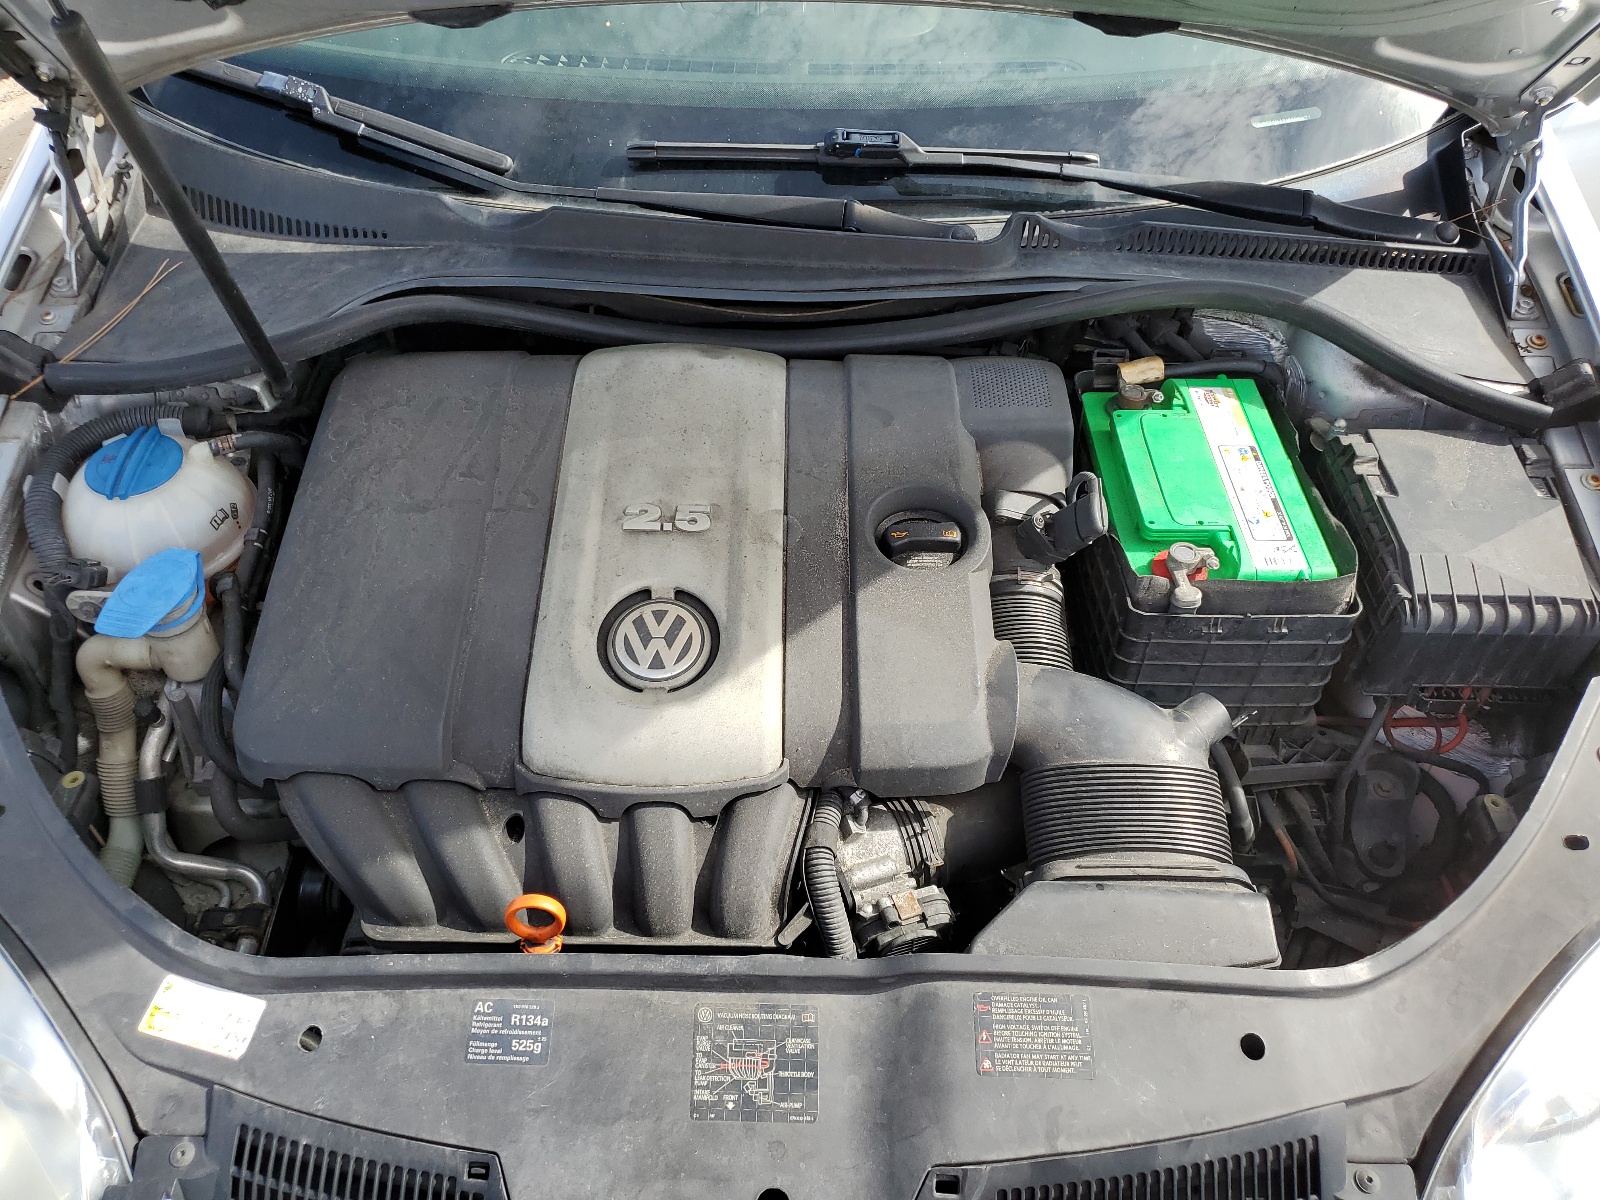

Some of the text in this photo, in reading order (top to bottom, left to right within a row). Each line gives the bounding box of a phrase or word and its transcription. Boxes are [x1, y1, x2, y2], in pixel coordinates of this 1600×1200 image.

[622, 503, 711, 532] 2.5
[611, 600, 705, 682] VW
[474, 1001, 493, 1013] AC
[510, 1014, 548, 1026] R134a
[511, 1040, 542, 1054] 525g
